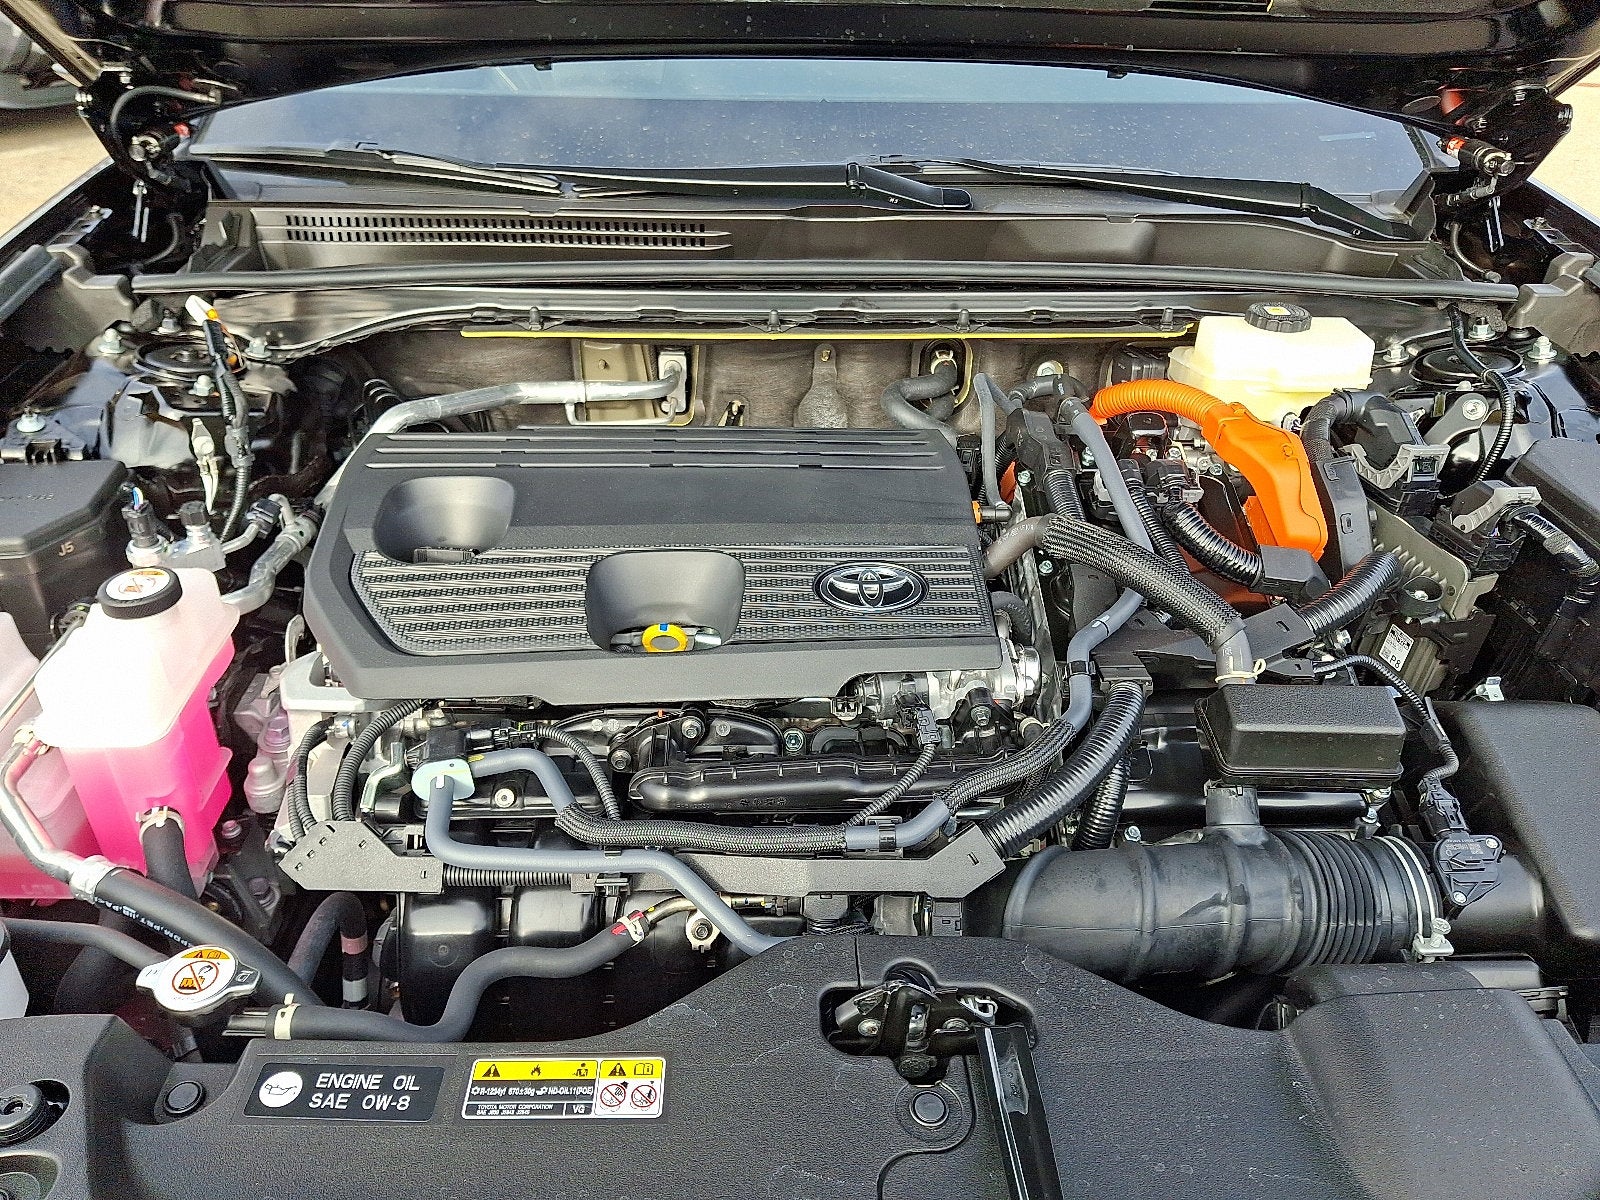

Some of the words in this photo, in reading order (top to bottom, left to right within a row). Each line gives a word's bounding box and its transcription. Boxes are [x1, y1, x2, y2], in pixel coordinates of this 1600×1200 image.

[58, 541, 75, 557] J5
[315, 1073, 384, 1090] ENGINE
[392, 1074, 421, 1091] OIL
[308, 1092, 351, 1110] SAE
[361, 1093, 411, 1111] 0W-8
[572, 1104, 585, 1114] VG
